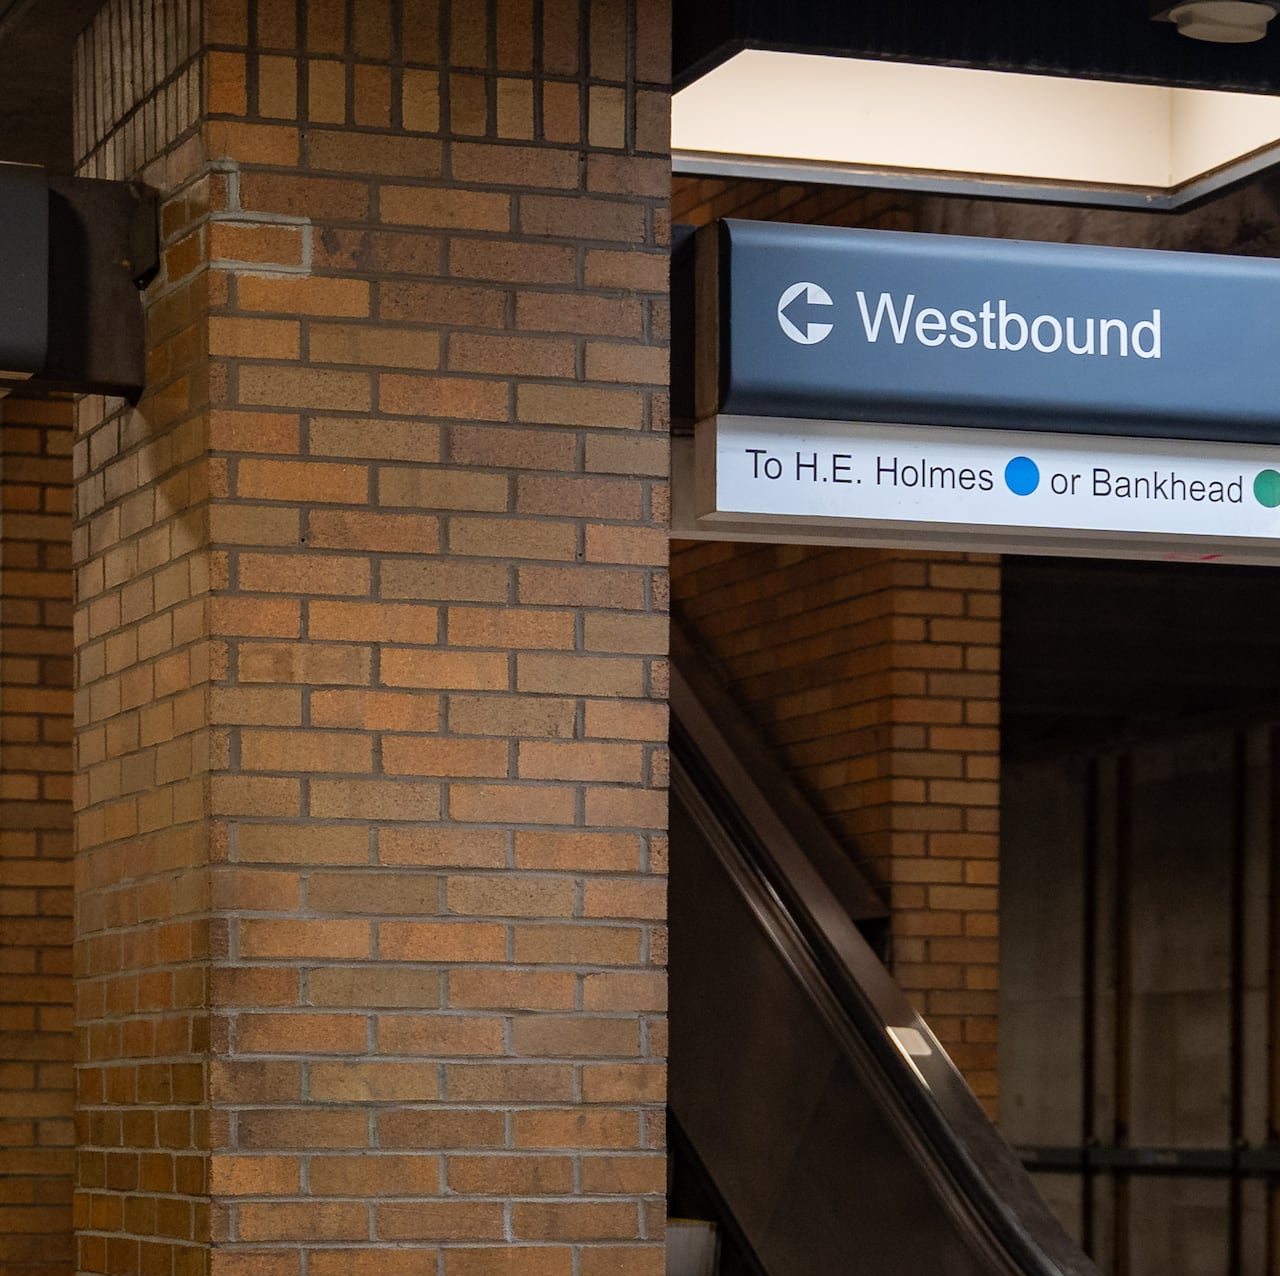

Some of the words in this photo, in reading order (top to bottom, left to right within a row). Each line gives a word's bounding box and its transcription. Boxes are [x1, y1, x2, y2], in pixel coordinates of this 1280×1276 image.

[856, 292, 1160, 358] Westbound
[746, 449, 782, 479] To
[796, 452, 861, 484] H.E.
[877, 457, 993, 490] Holmes
[1052, 474, 1081, 494] or
[1093, 468, 1242, 503] Bankhead
